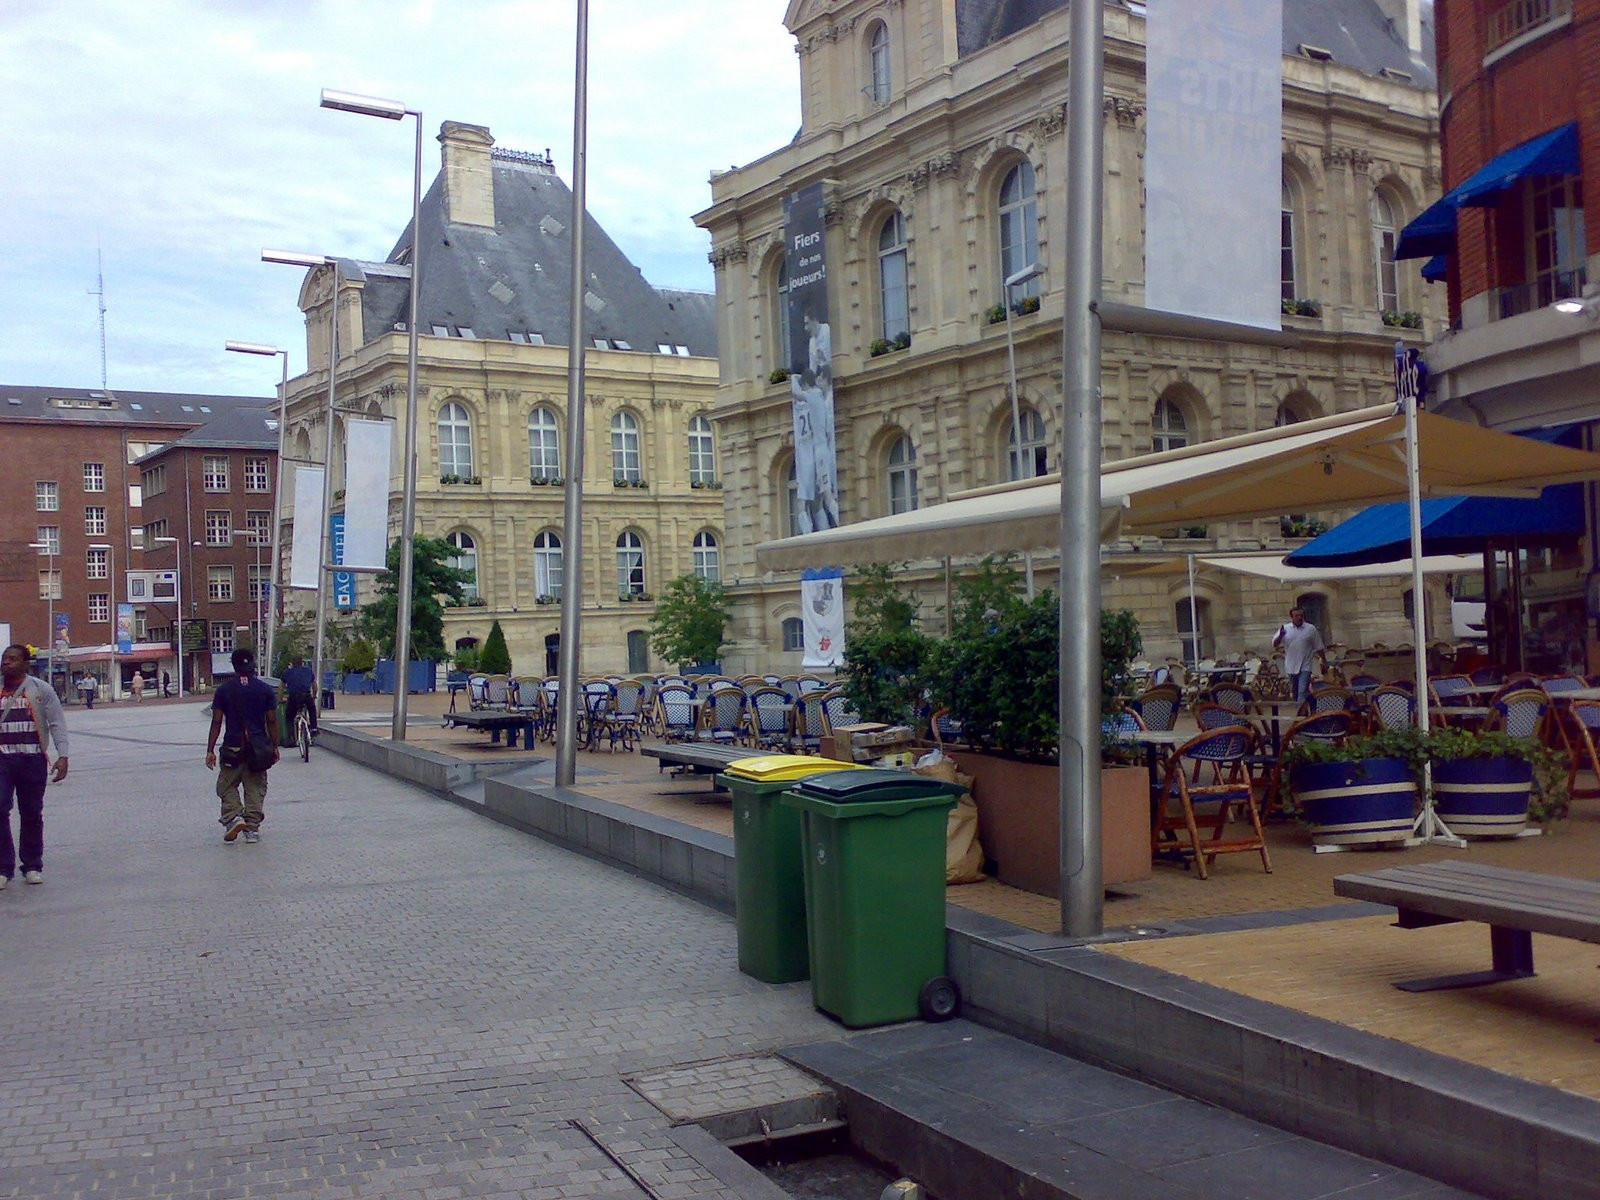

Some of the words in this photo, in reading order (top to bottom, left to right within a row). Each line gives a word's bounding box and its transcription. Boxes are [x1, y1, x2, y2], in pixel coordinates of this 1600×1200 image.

[794, 231, 820, 250] Fiers
[799, 256, 809, 267] de
[789, 264, 826, 293] joueurs!
